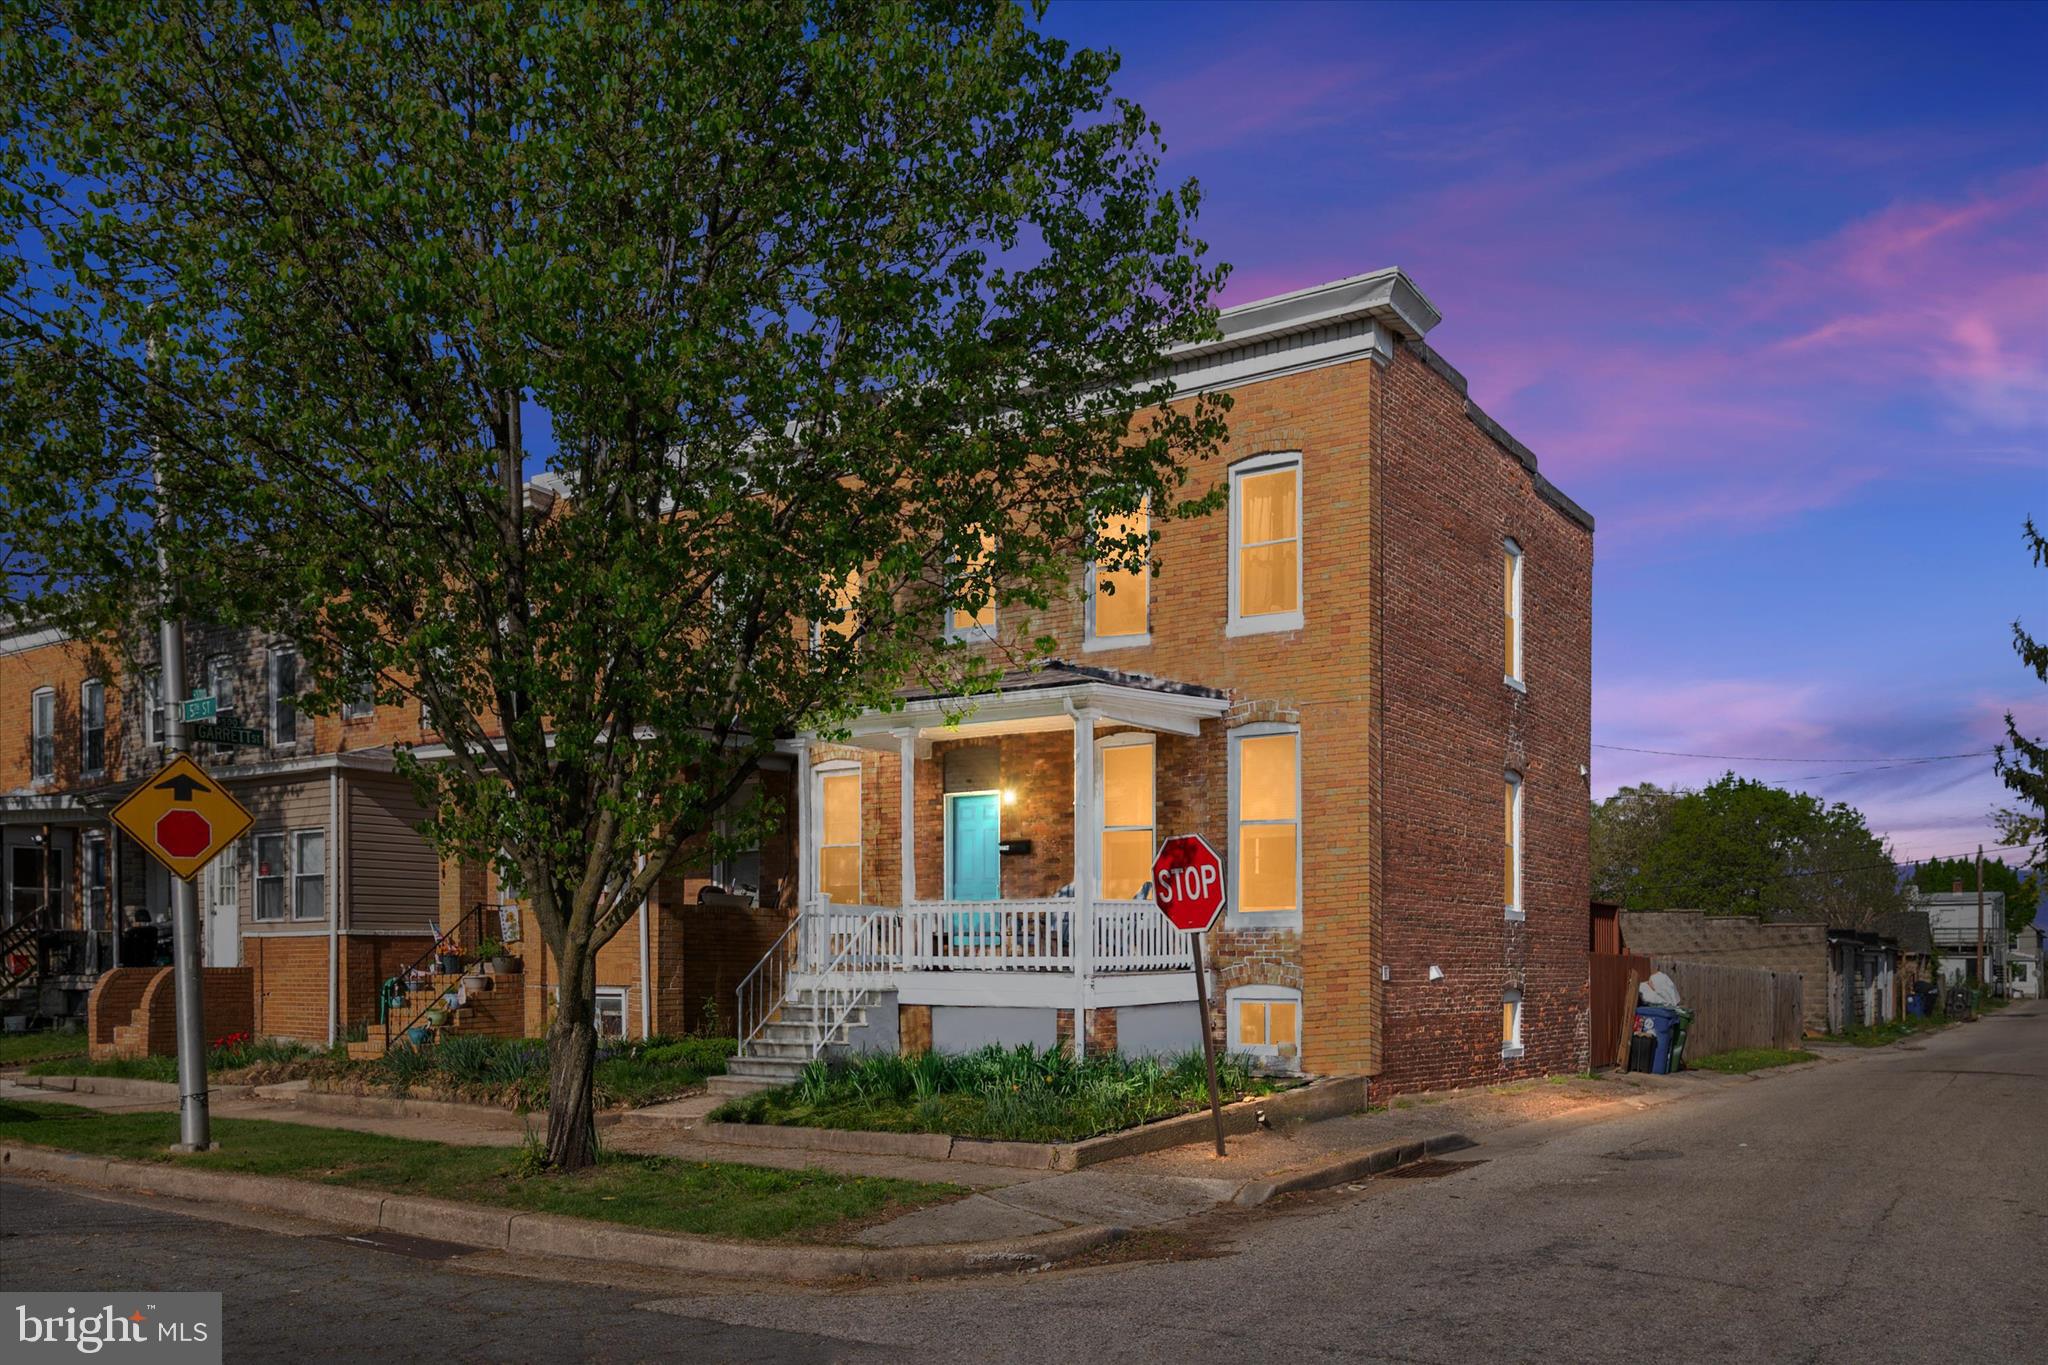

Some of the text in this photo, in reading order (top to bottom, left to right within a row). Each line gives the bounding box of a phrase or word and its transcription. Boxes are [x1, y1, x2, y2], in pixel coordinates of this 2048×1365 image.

[202, 701, 210, 716] ST
[198, 725, 261, 745] GARRETT ST
[1158, 864, 1216, 903] STOP
